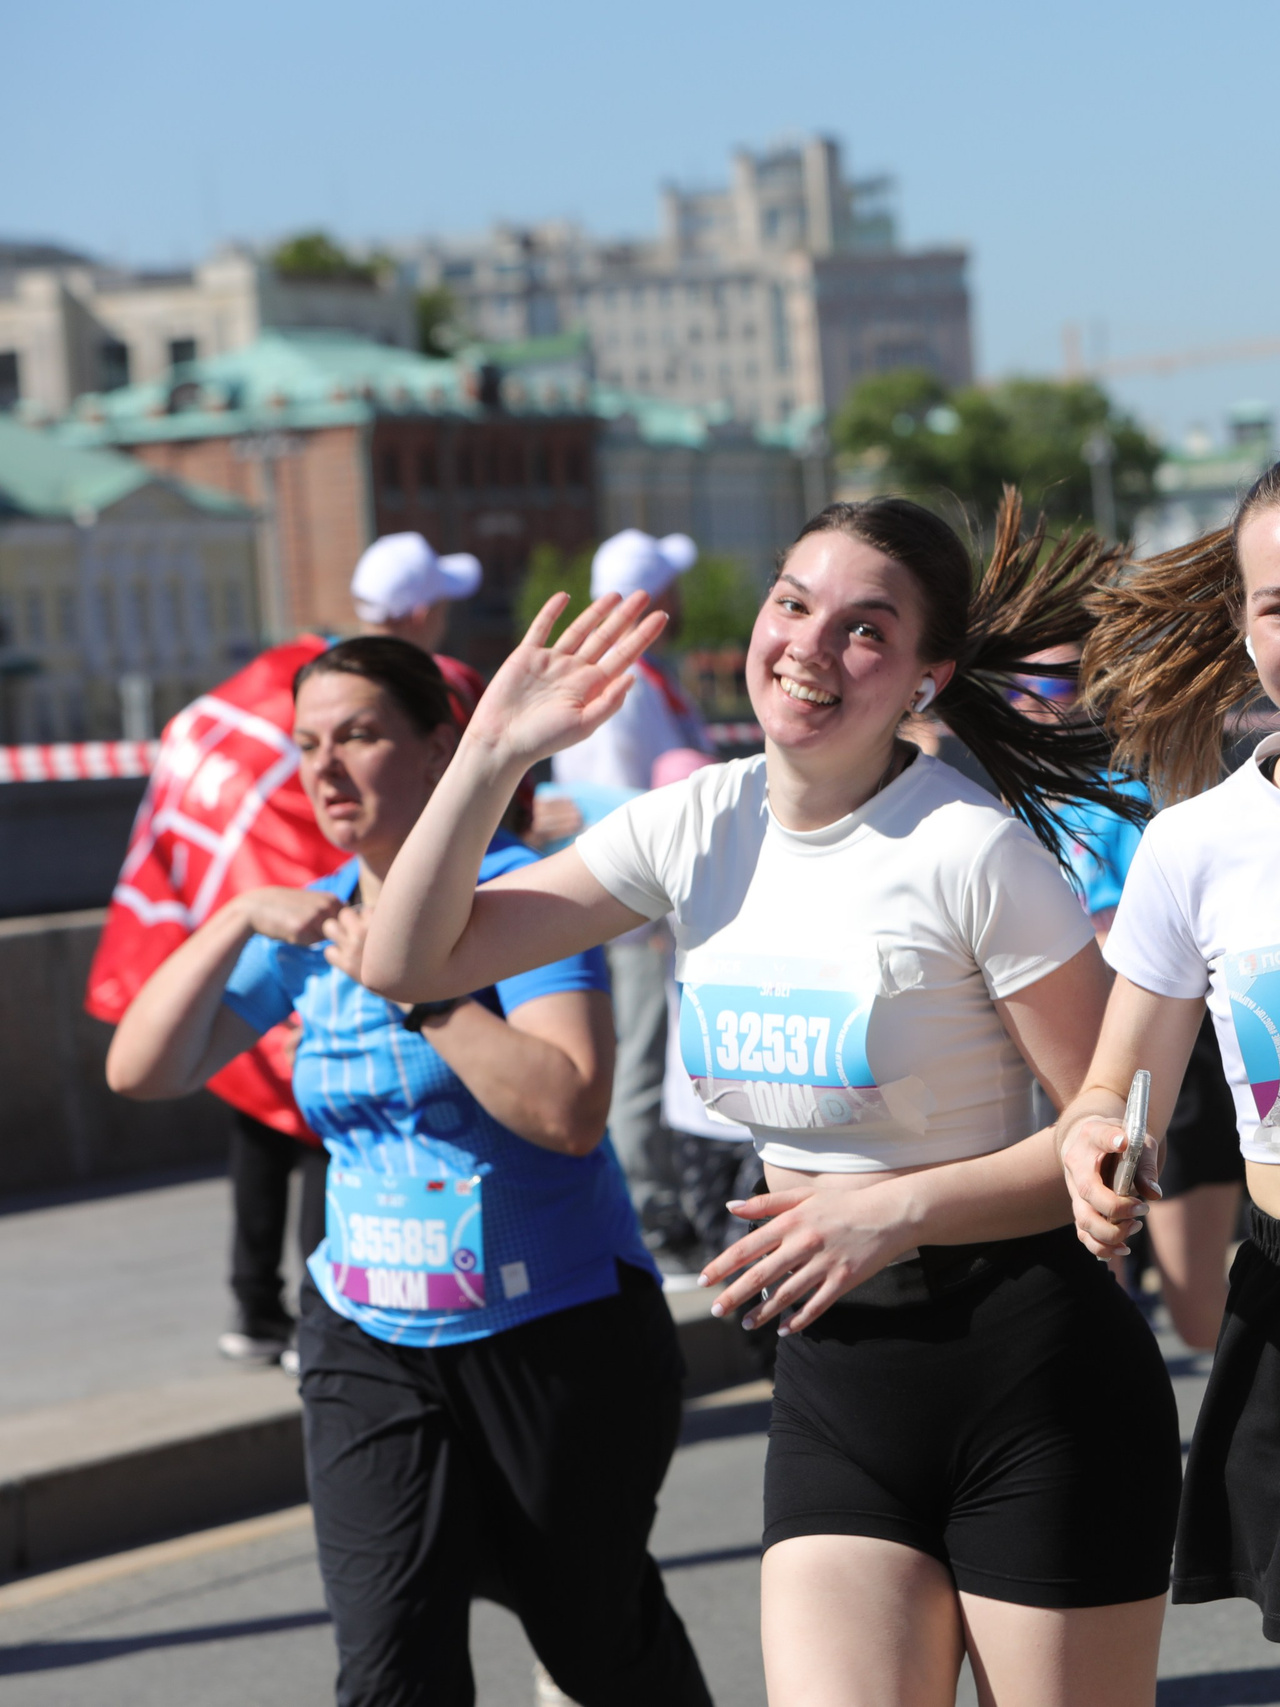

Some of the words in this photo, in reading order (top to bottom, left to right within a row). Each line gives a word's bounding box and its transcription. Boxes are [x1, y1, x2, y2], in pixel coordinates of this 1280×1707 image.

[716, 1010, 831, 1077] 32537
[826, 1099, 845, 1118] D
[348, 1212, 448, 1267] 35585
